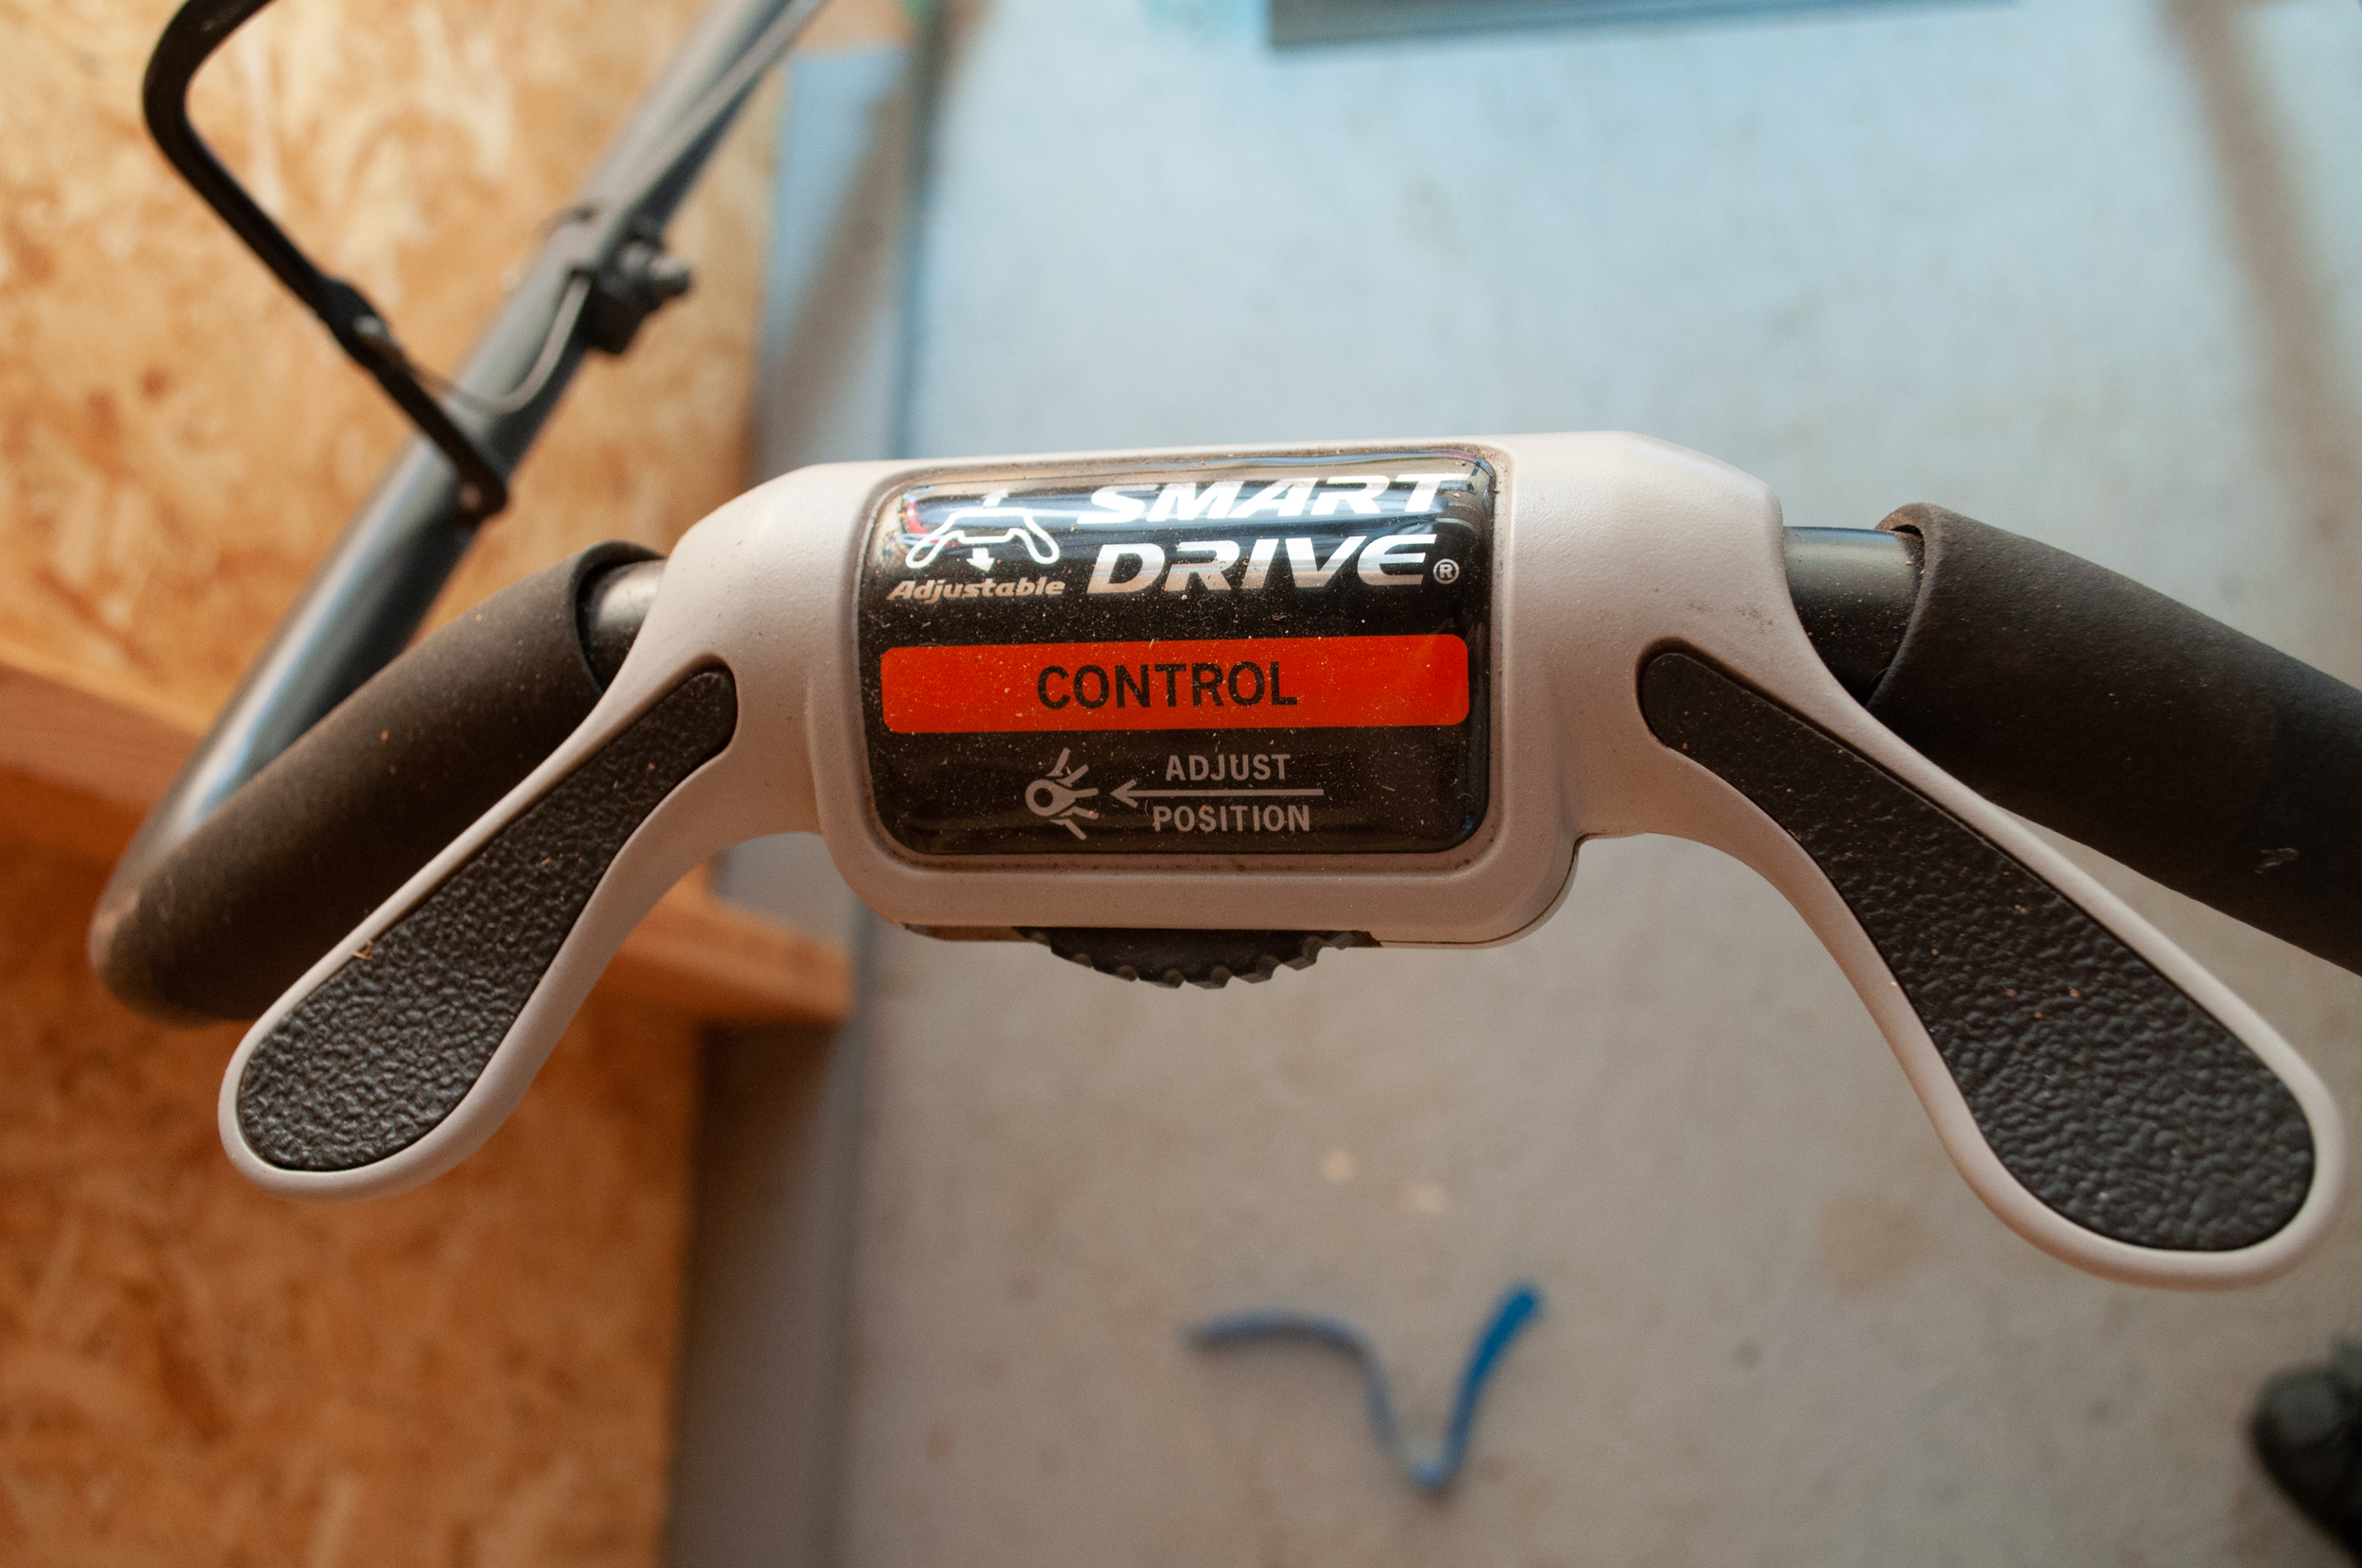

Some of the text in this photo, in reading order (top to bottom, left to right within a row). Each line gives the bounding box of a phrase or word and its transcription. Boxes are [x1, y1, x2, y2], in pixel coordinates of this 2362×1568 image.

[1076, 473, 1467, 525] SMART
[886, 576, 1066, 603] Adjustable
[1037, 661, 1298, 709] CONTROL
[1165, 754, 1291, 782] ADJUST
[1153, 805, 1310, 833] POSITION
